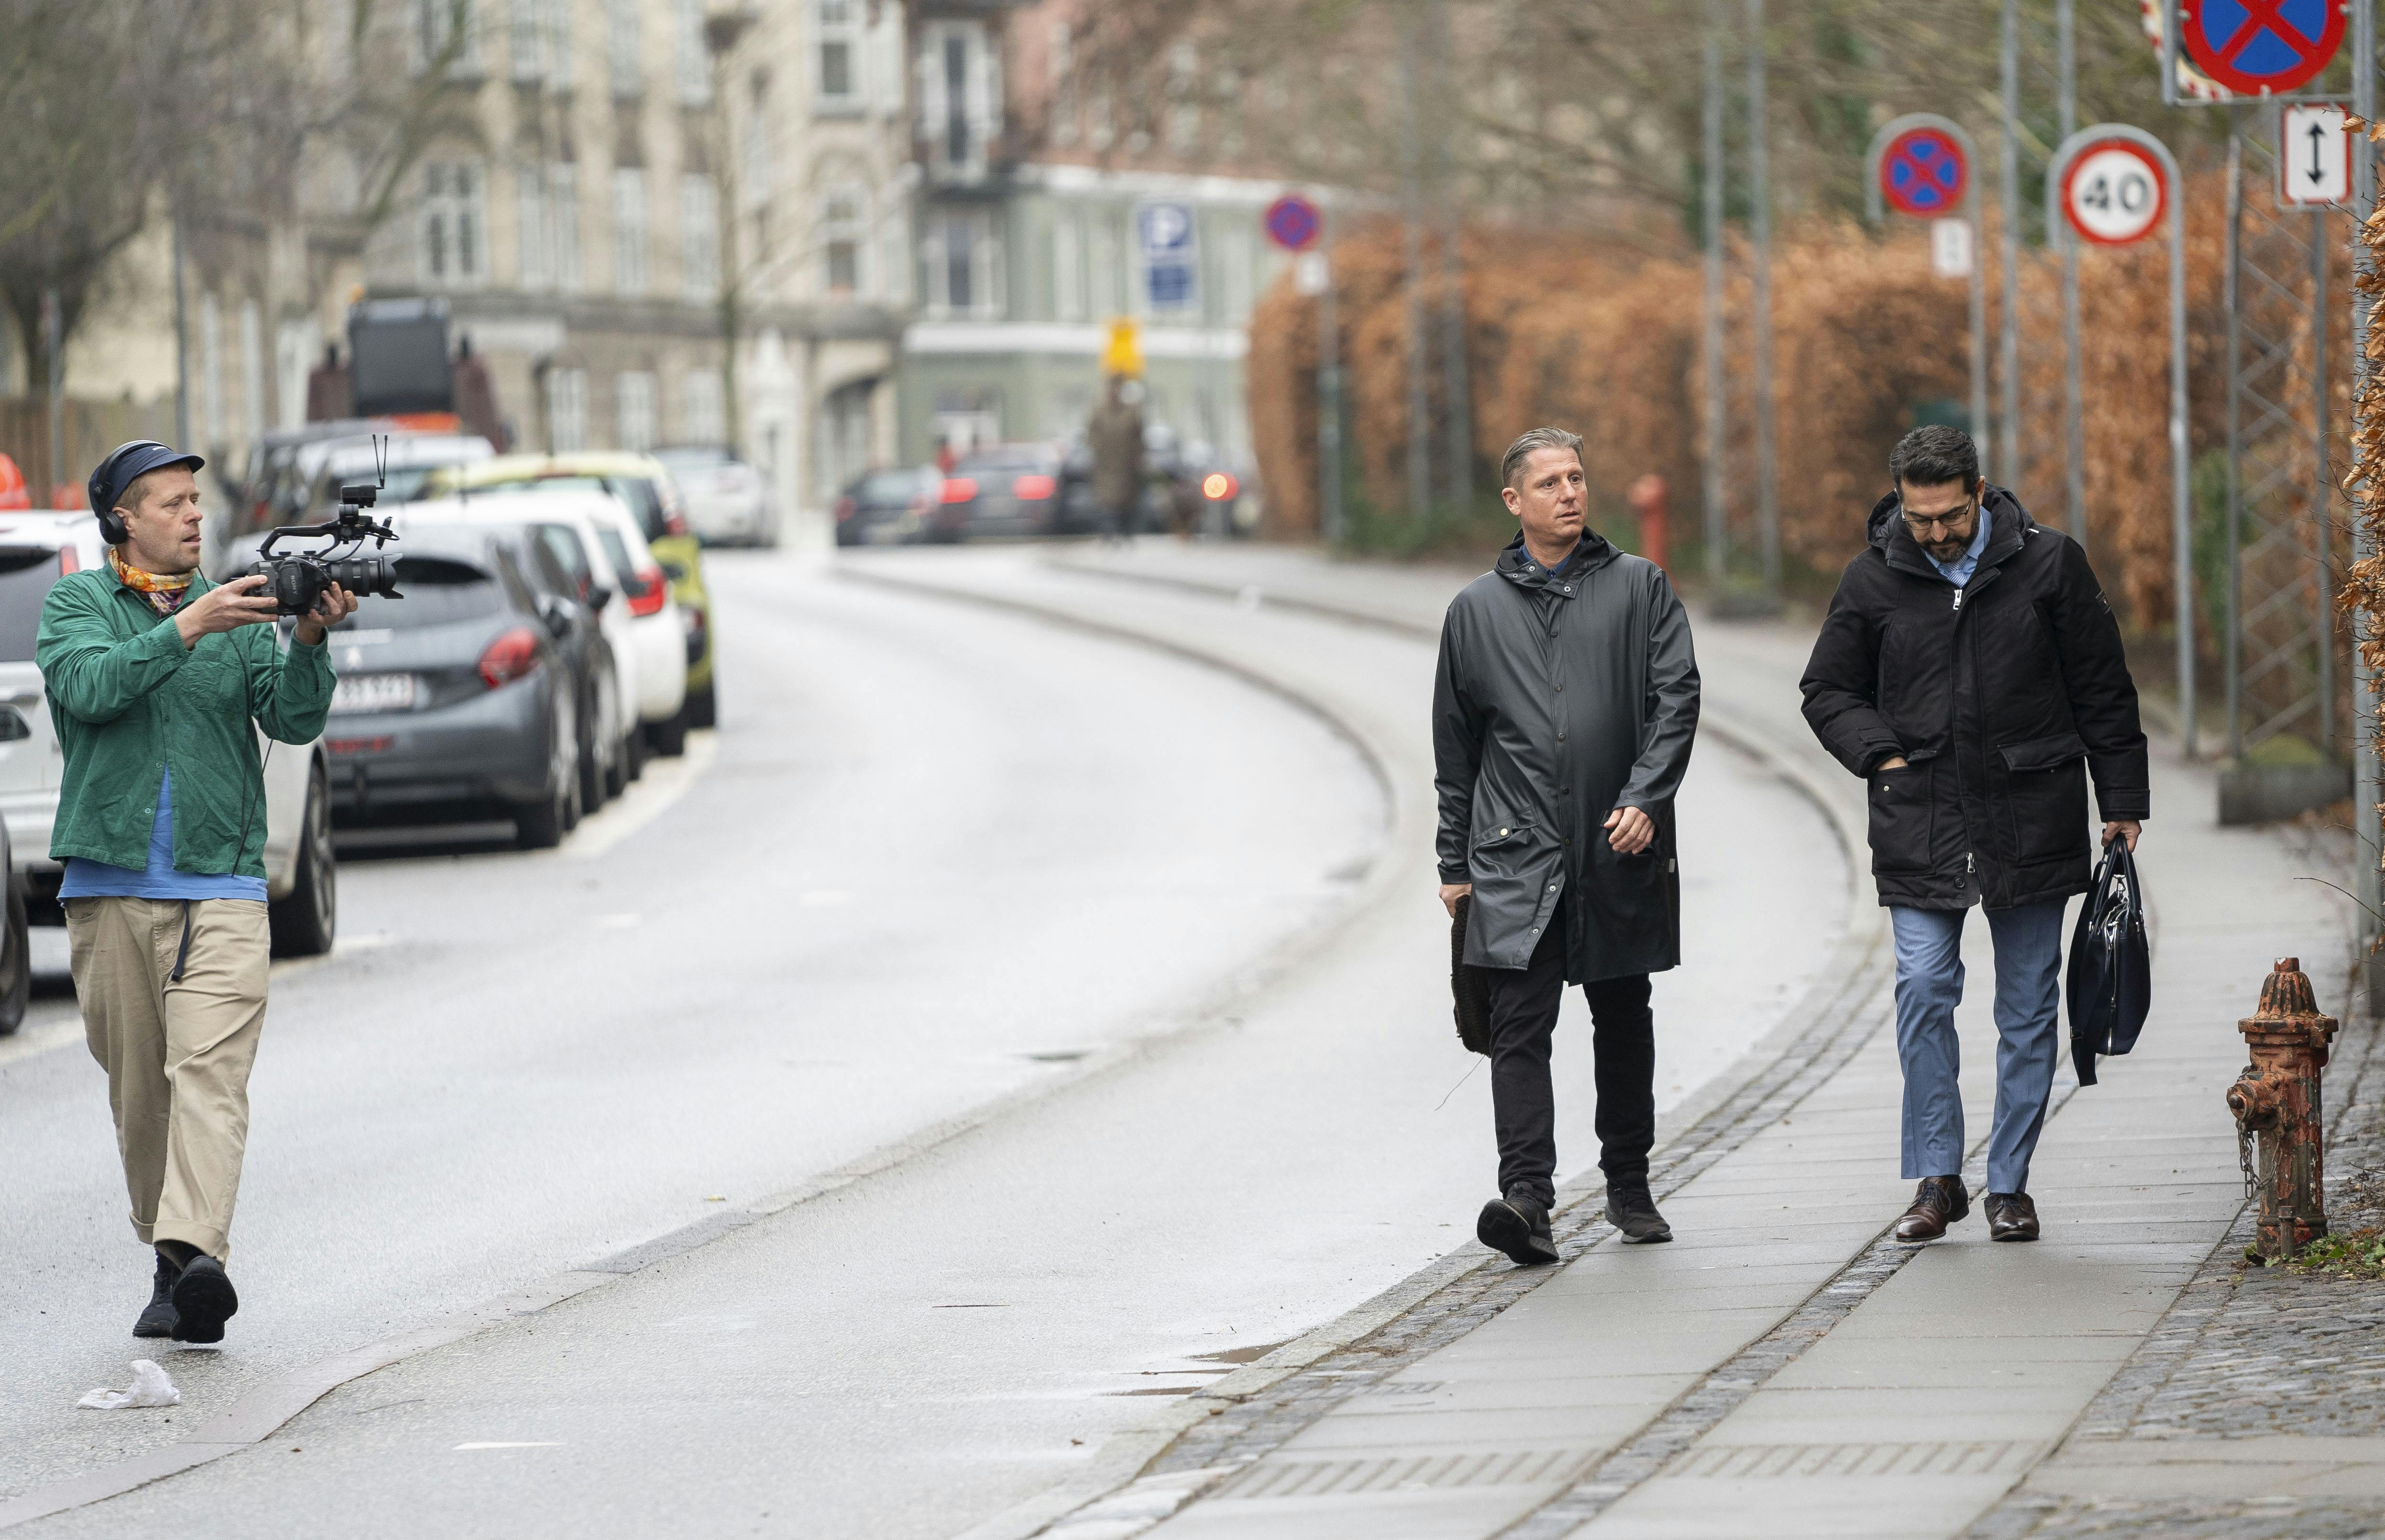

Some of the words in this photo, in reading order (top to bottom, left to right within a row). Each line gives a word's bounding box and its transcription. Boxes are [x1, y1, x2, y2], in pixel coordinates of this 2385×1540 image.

[2084, 173, 2149, 214] 40
[1153, 207, 1185, 246] P
[290, 575, 298, 595] SONY
